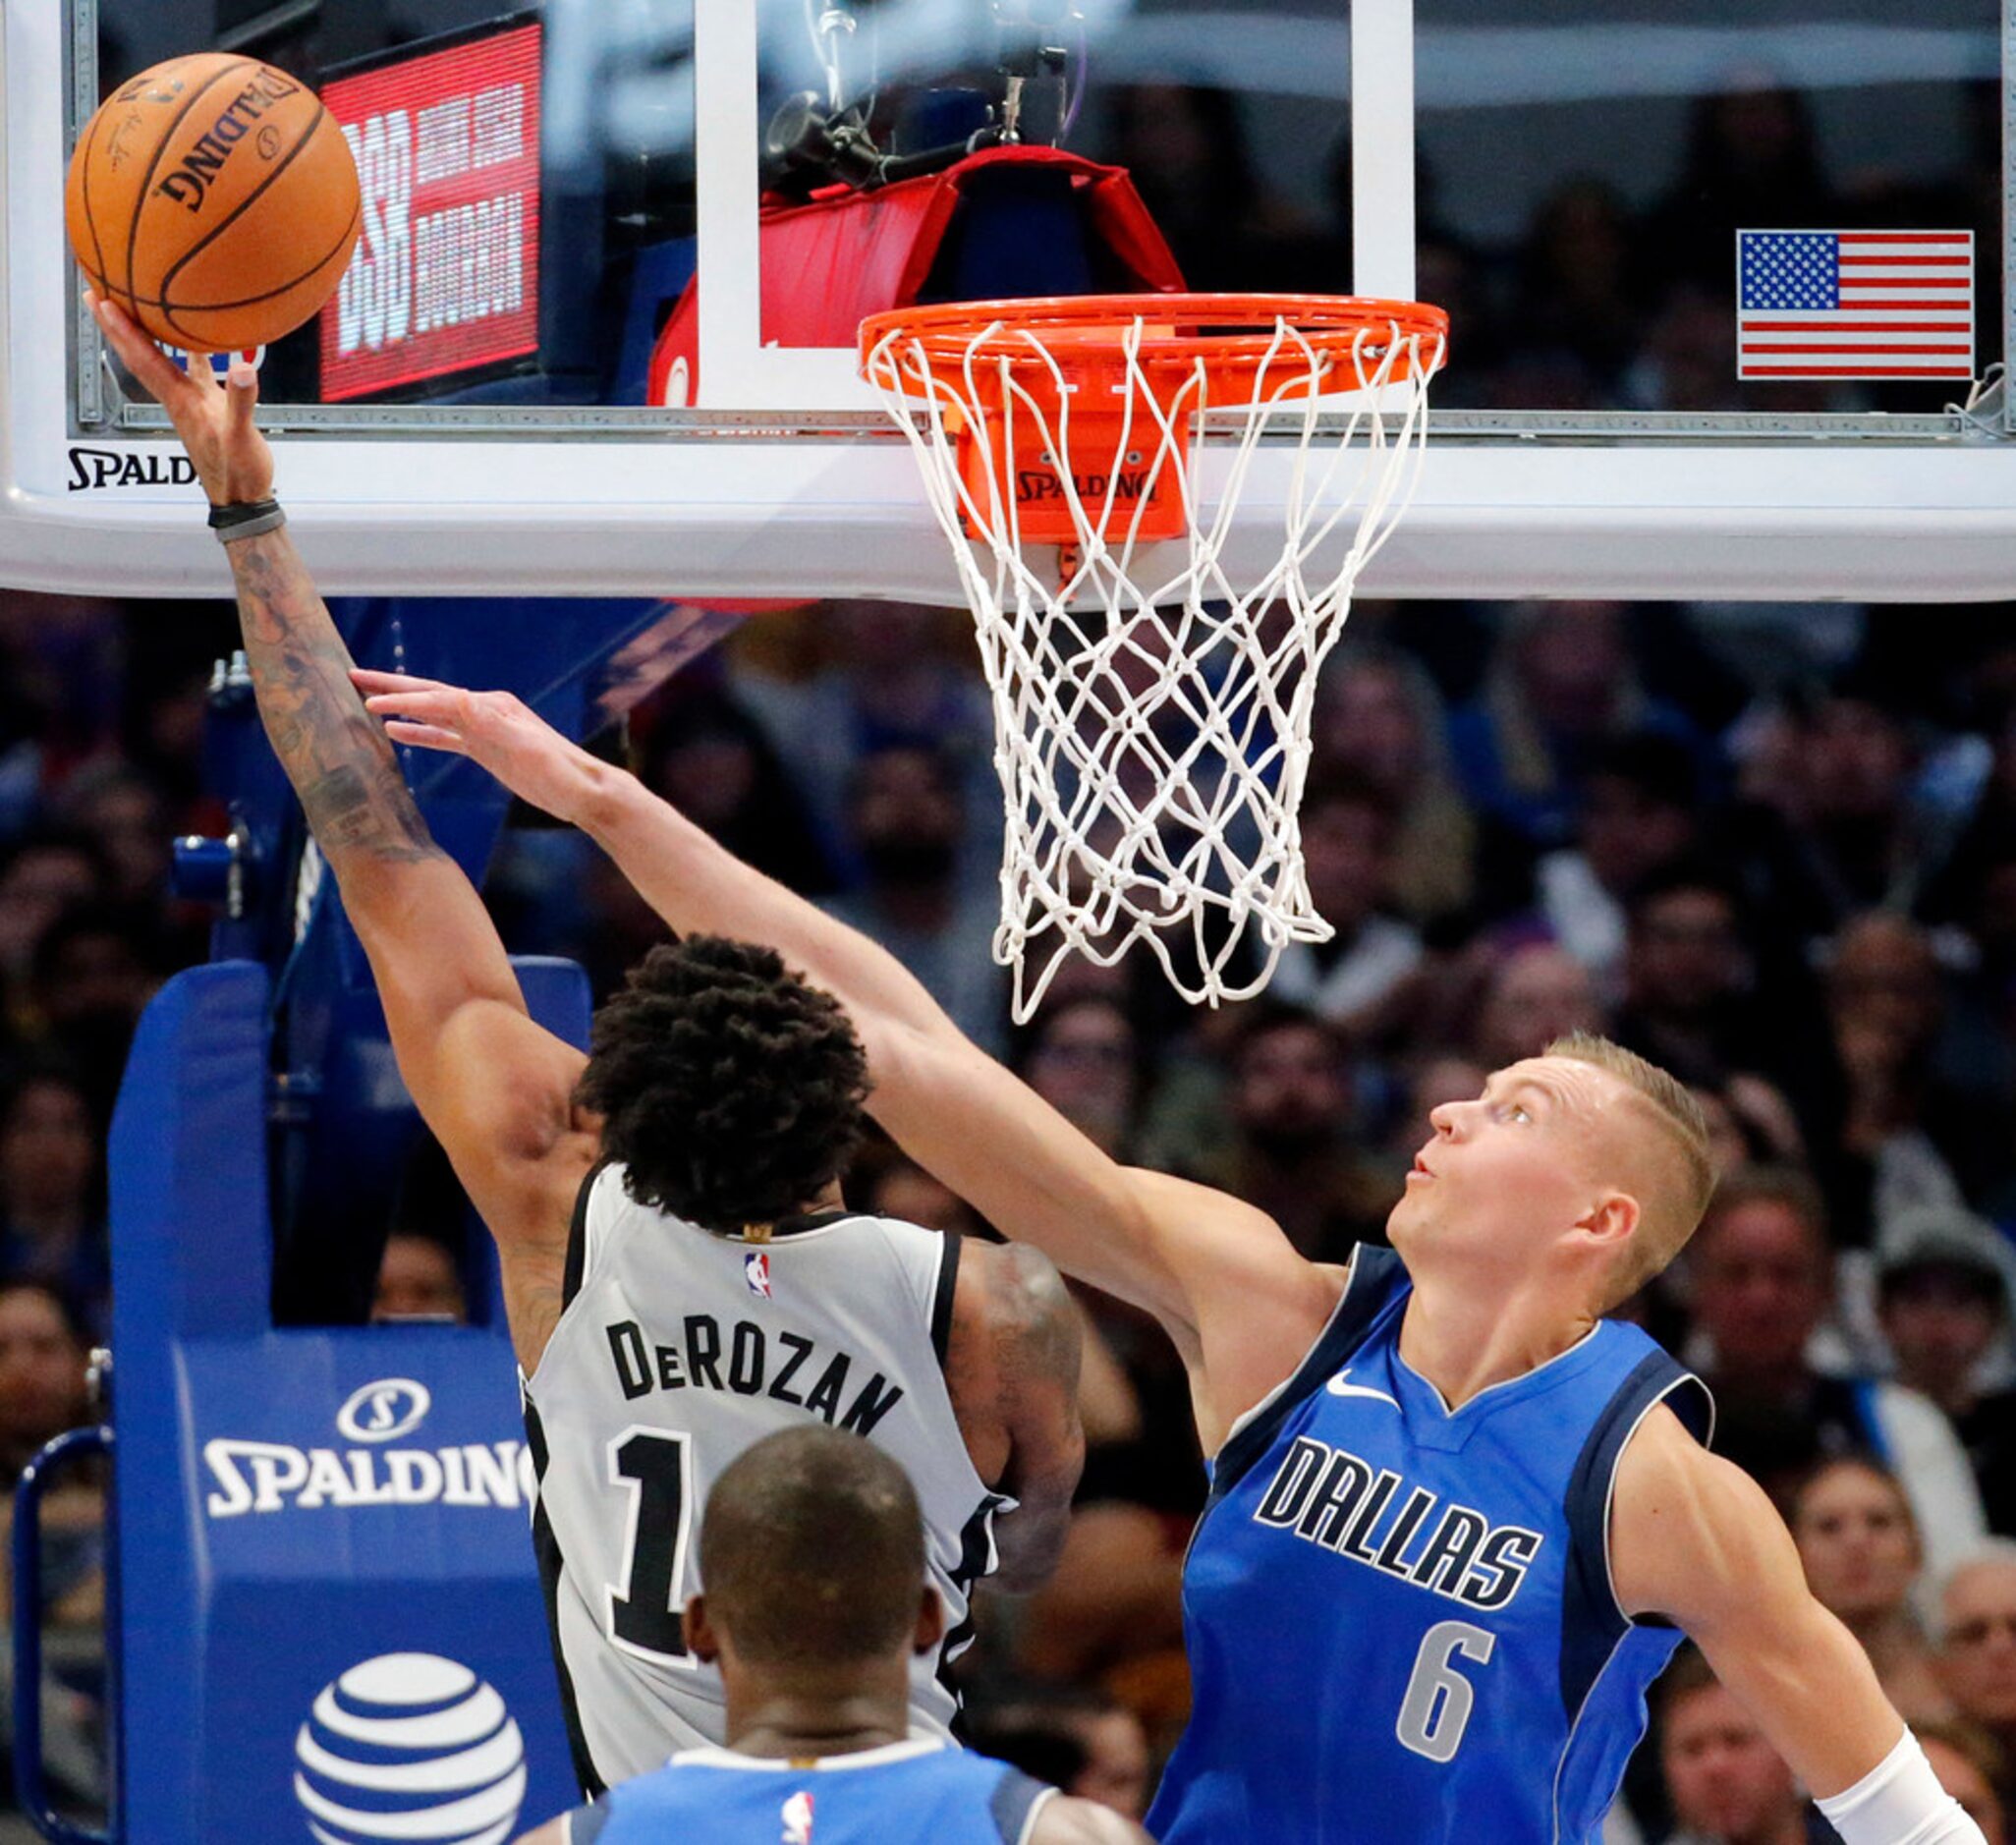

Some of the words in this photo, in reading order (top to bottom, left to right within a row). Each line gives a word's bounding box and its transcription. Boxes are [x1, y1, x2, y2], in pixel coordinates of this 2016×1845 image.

[415, 192, 524, 332] BOURBON
[68, 447, 202, 491] SPALD
[1018, 471, 1157, 502] SPLDNG
[1253, 1435, 1544, 1611] DALLAS
[1395, 1620, 1496, 1763] 6
